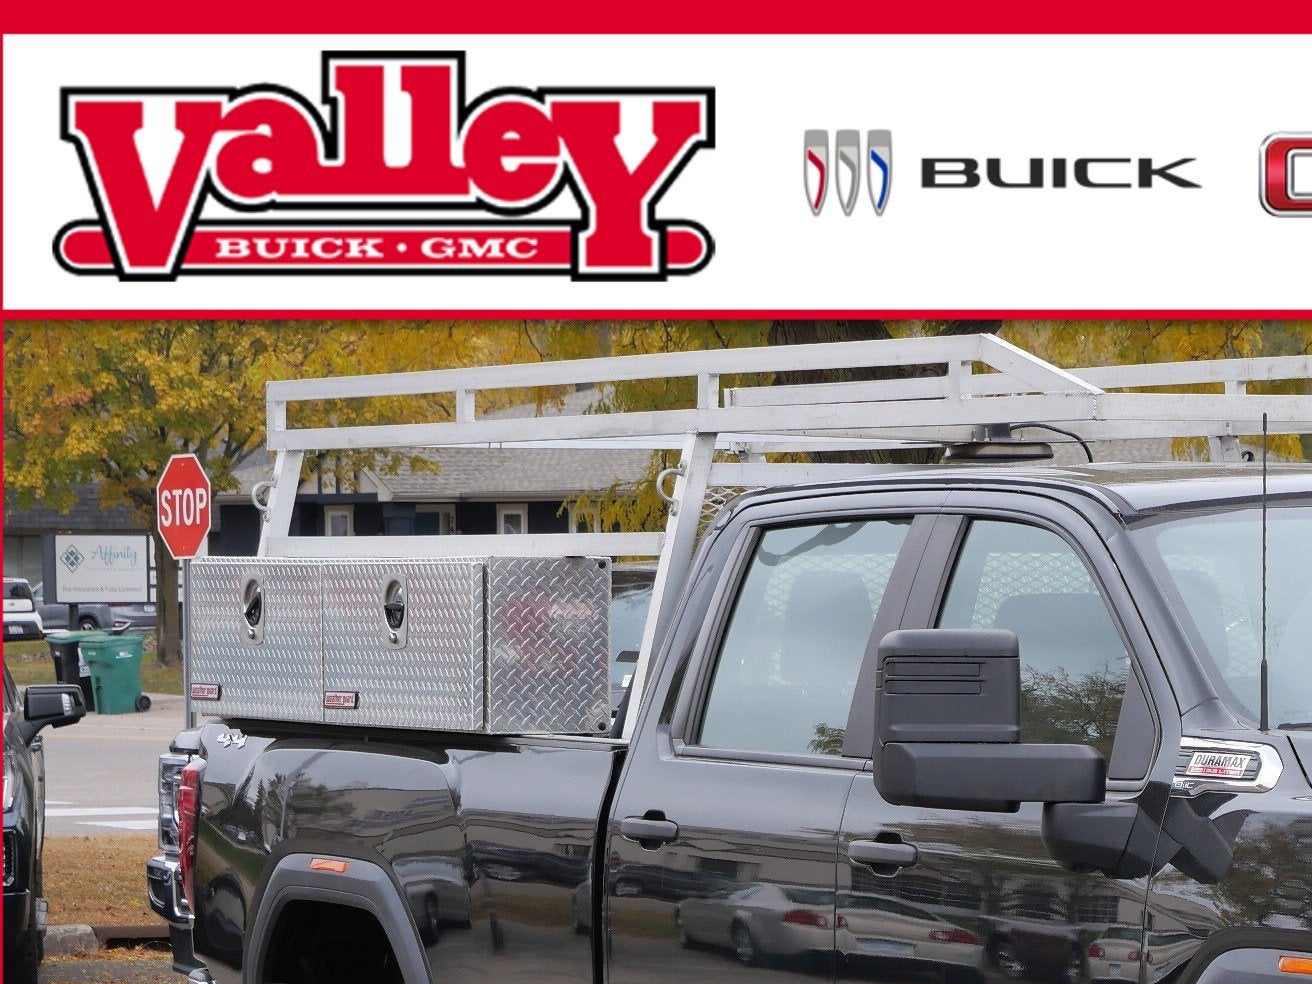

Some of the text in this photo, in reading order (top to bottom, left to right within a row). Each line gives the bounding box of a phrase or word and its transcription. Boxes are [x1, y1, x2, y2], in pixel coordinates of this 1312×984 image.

[161, 487, 208, 527] STOP
[91, 545, 138, 567] Affinity
[1194, 754, 1246, 769] DURAMAX
